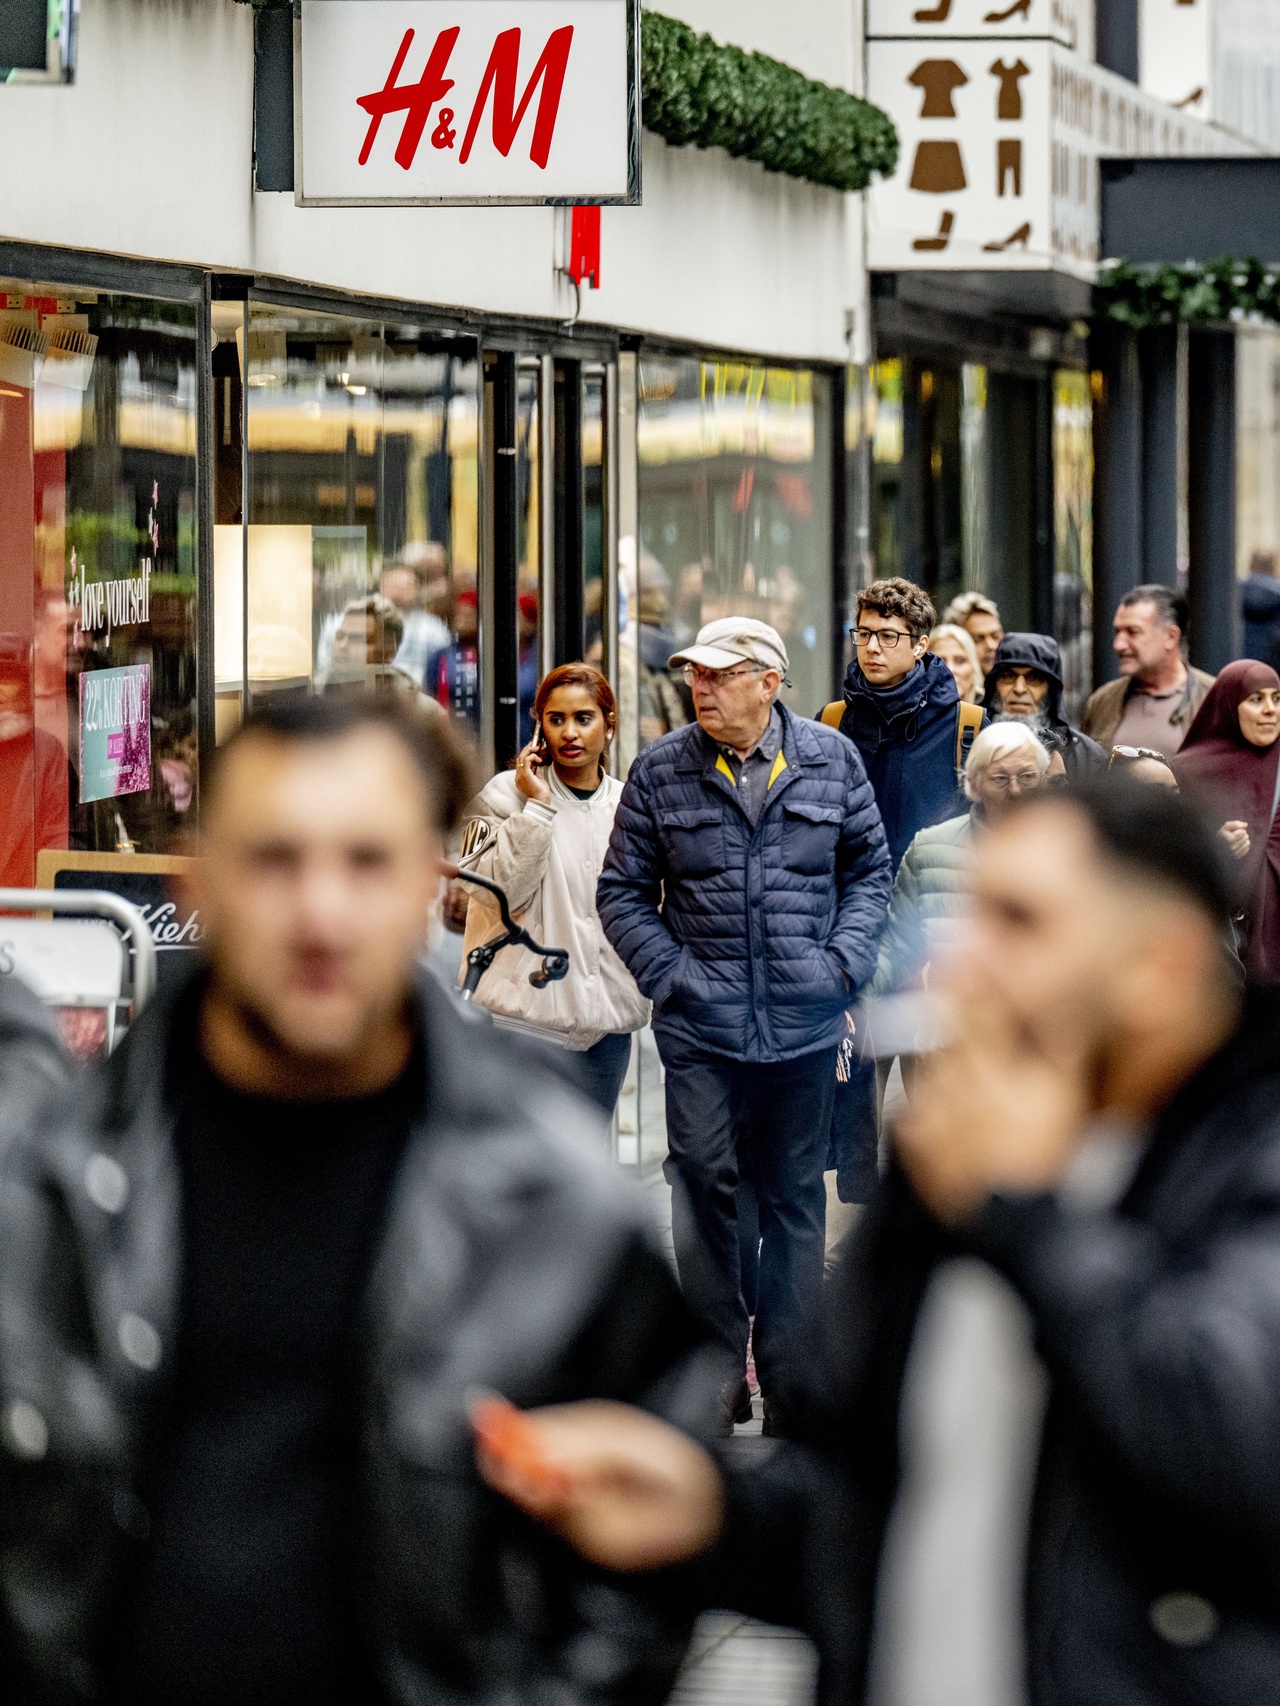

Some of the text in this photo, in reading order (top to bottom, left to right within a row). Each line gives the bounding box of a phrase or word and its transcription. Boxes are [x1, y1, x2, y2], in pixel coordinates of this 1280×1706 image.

[356, 24, 575, 171] H&M
[81, 557, 152, 648] love yourself
[103, 674, 147, 729] KORTING
[121, 902, 207, 946] Kieh
